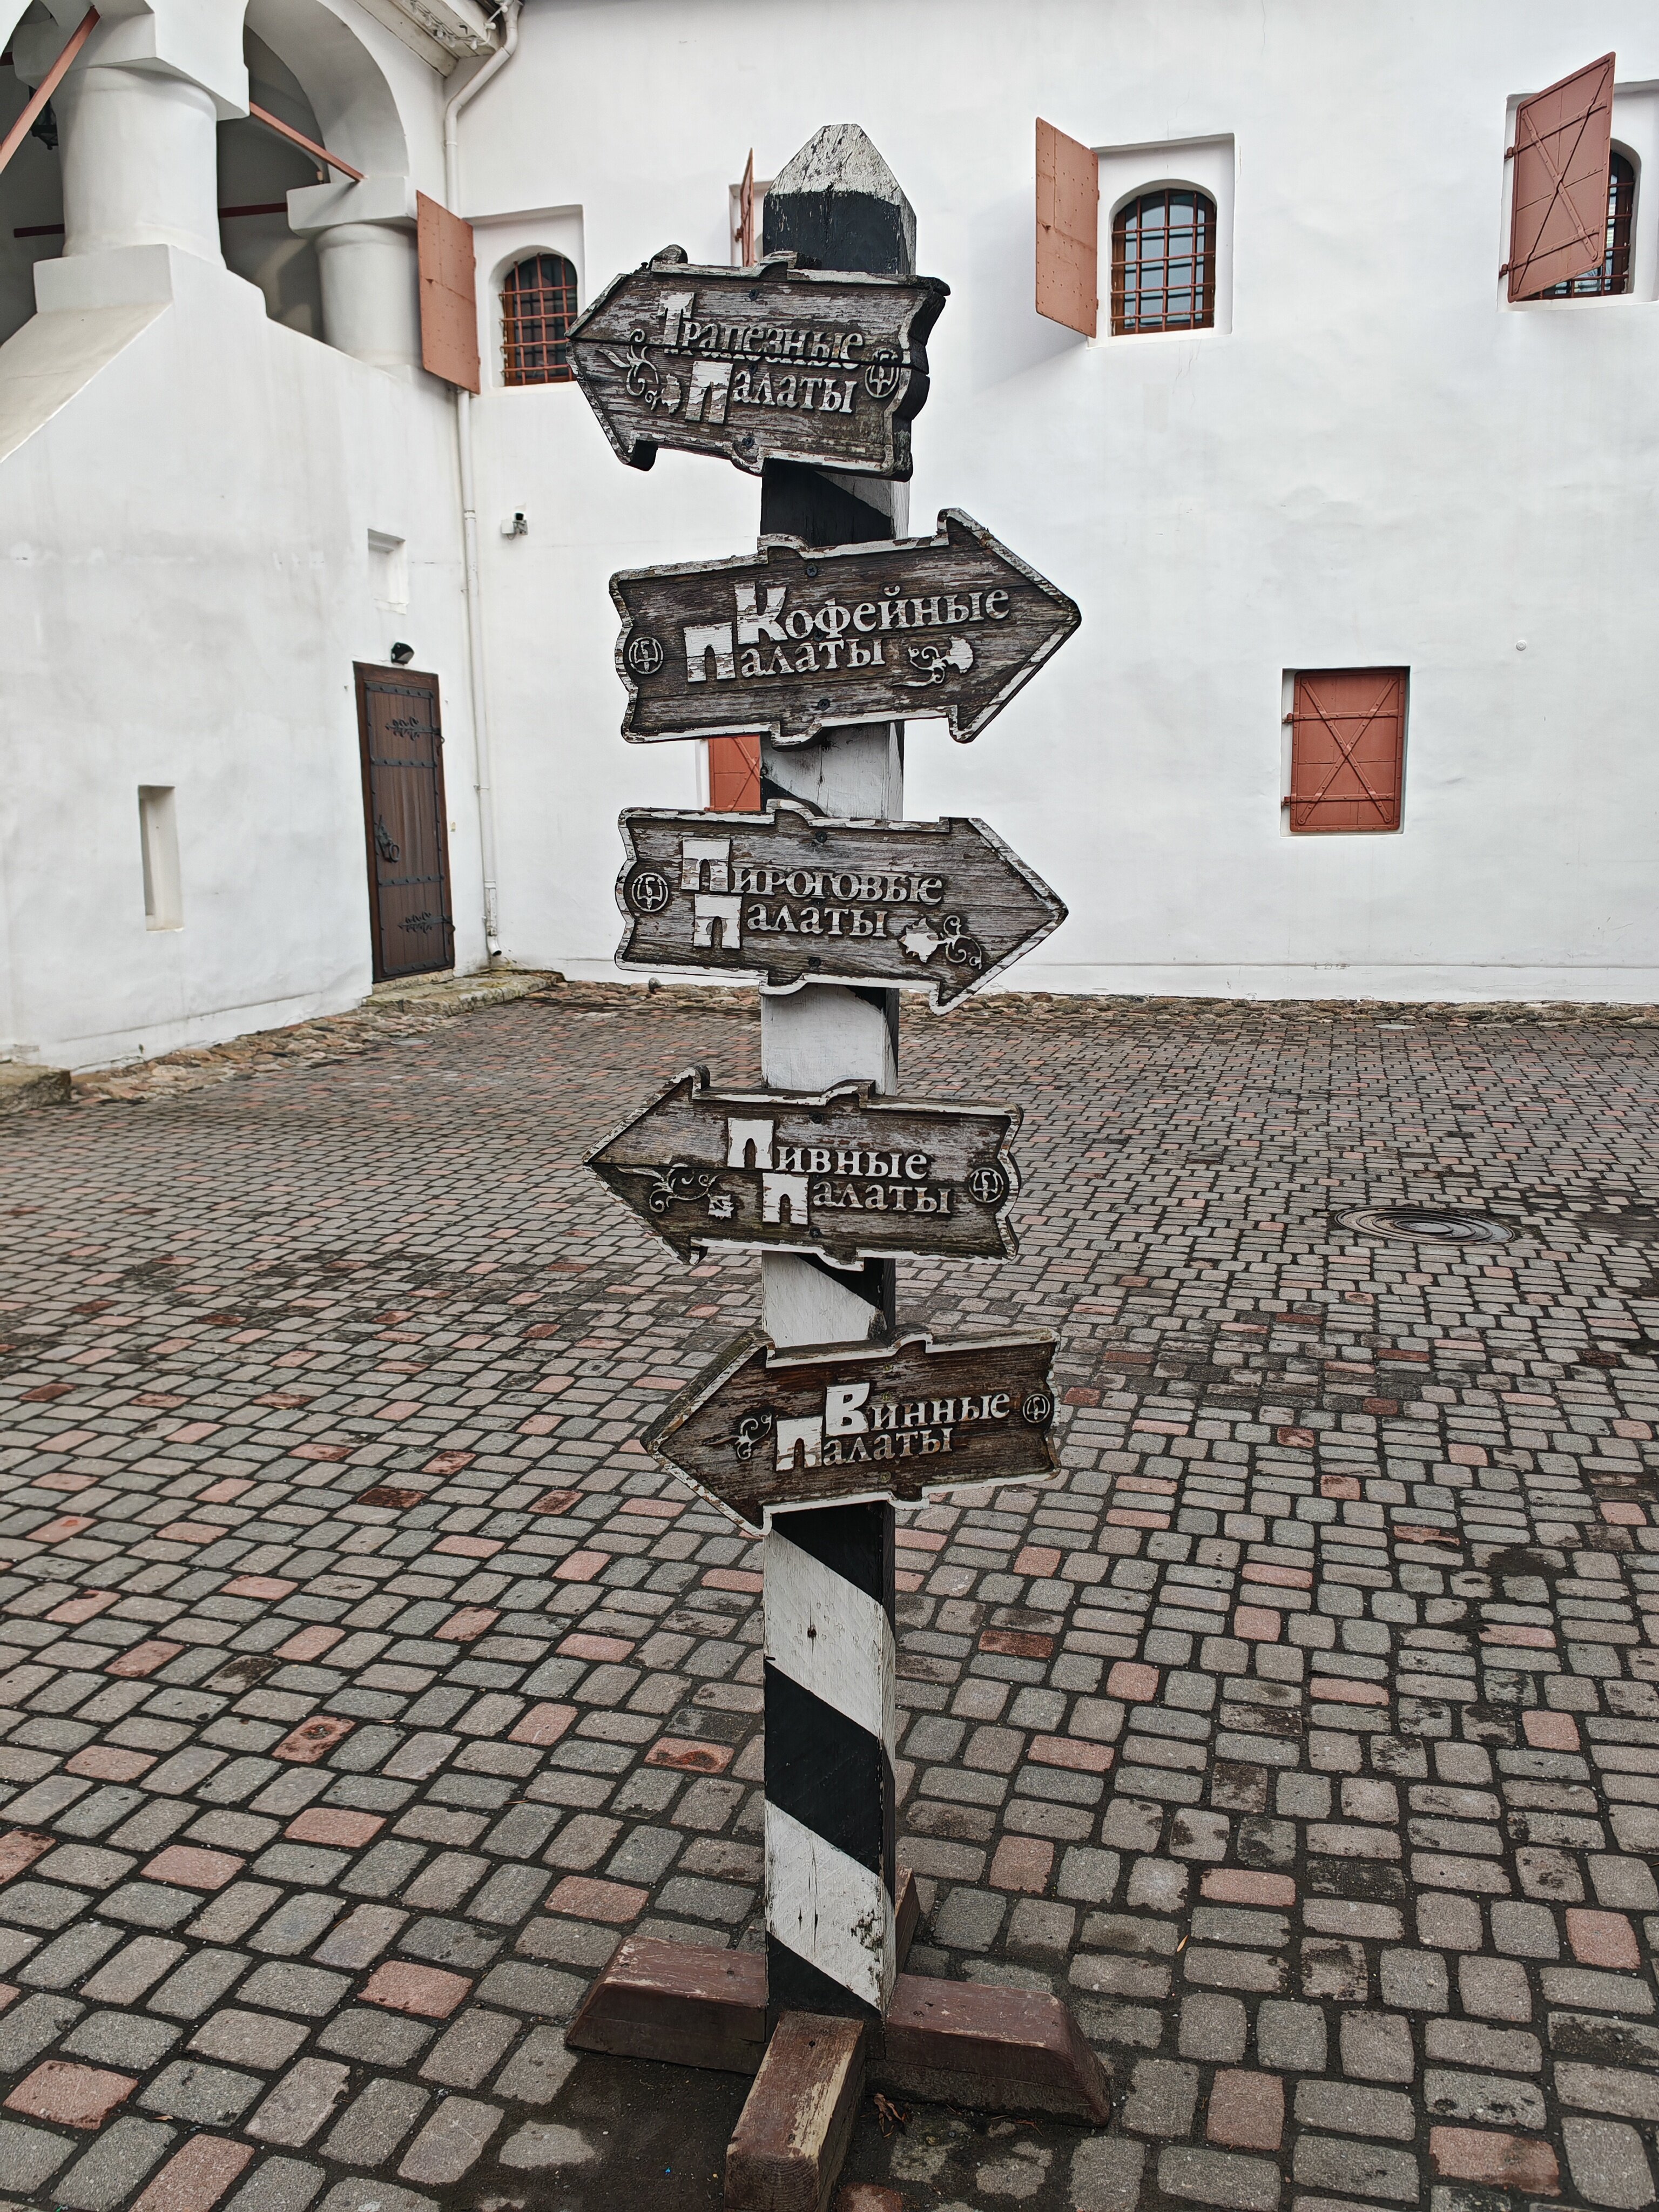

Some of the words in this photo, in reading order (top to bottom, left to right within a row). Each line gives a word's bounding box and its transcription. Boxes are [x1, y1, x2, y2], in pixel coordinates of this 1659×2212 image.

[685, 360, 858, 424] Палаты
[733, 581, 1010, 644] Кофейные
[684, 622, 886, 683] Палаты
[681, 837, 944, 905] Пироговые
[693, 893, 888, 949] Палаты
[727, 1118, 928, 1180] Пивные
[762, 1172, 953, 1225] Палаты
[825, 1382, 1010, 1437] Винные
[776, 1415, 954, 1472] Палаты
